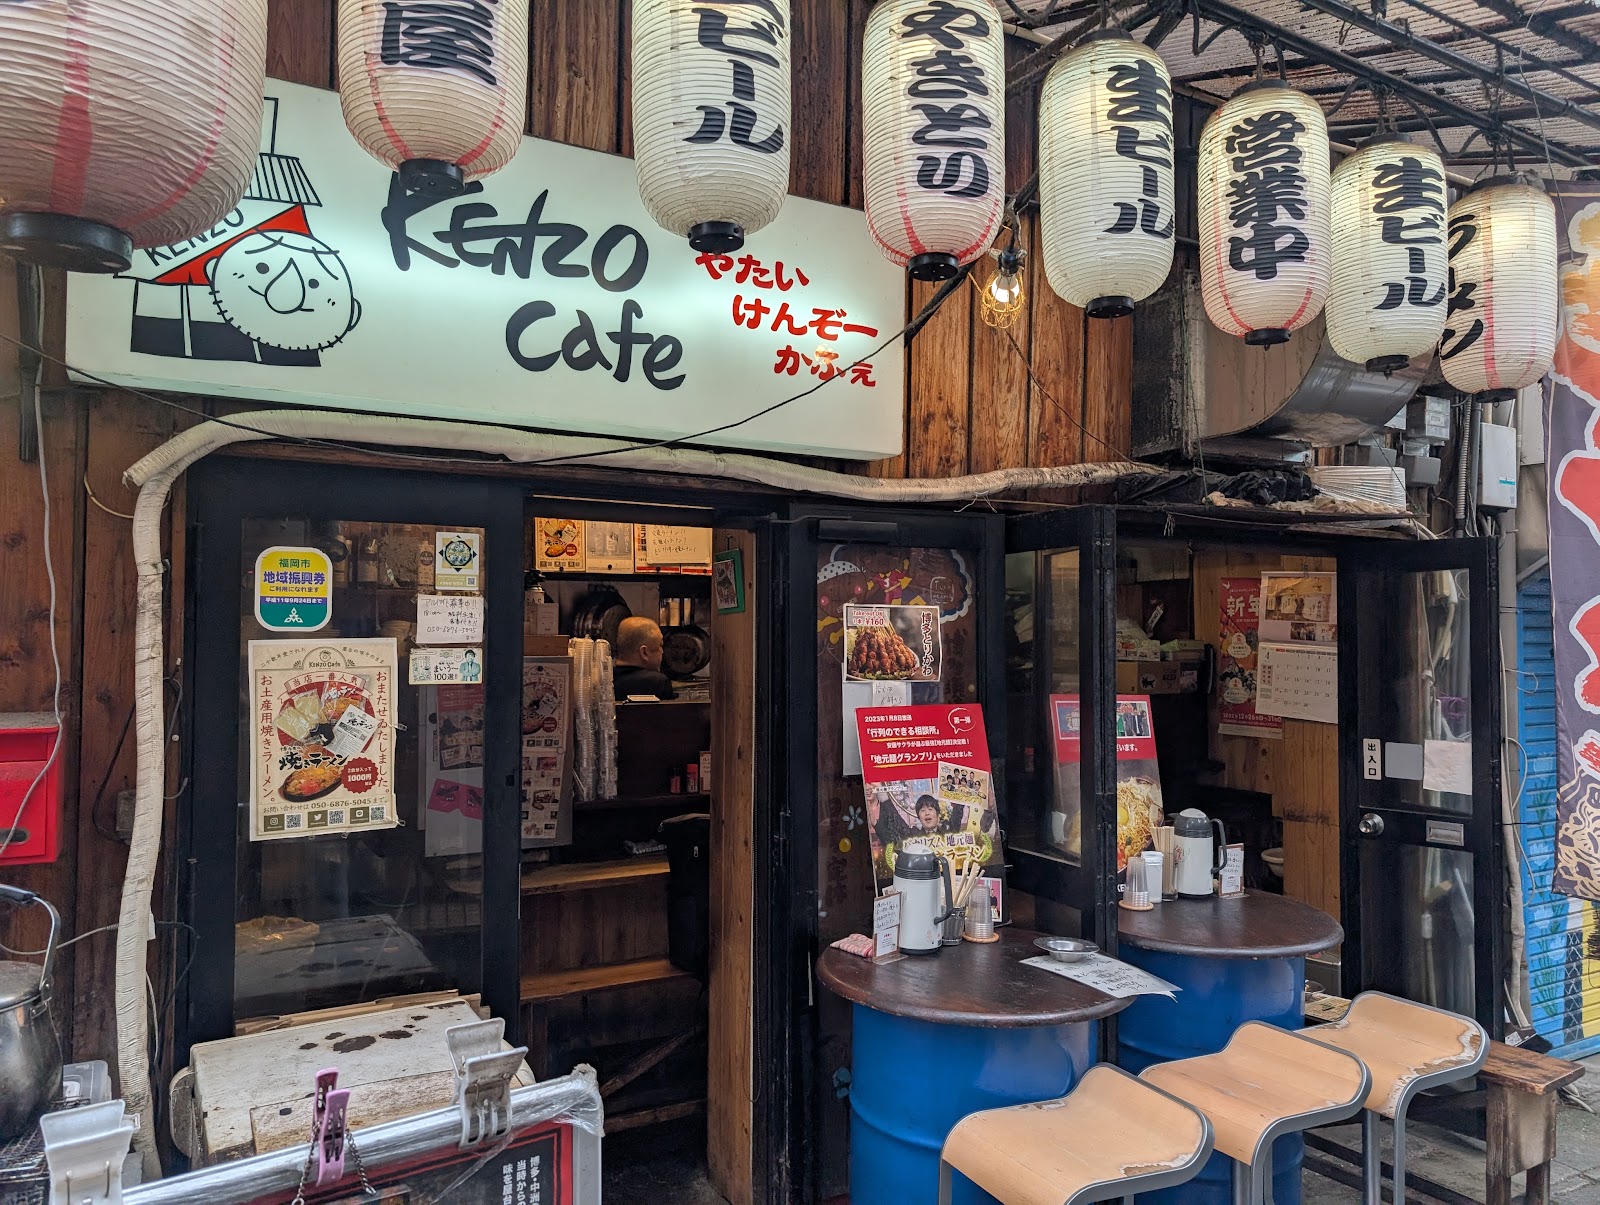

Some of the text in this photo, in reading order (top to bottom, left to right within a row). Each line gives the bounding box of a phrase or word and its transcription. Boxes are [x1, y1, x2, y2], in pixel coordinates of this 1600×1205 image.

[683, 0, 785, 154] ビール
[901, 0, 991, 198] やきとり
[1104, 59, 1174, 239] 生ビール
[1225, 110, 1310, 280] 営業中
[1372, 157, 1446, 310] 生ビール
[695, 251, 810, 292] やたい
[732, 294, 879, 342] けんぞー
[505, 299, 687, 391] Cafe
[263, 570, 326, 585] 地域振興券
[279, 558, 311, 569] 福岡市
[269, 585, 320, 593] ご利用になれます
[865, 617, 884, 626] ¥160
[921, 611, 935, 676] 博多とりかわ
[292, 672, 358, 686] 当店一番人気
[278, 751, 350, 771] 焼きラーメン
[347, 773, 372, 783] 1000円
[1367, 742, 1377, 775] 出入口
